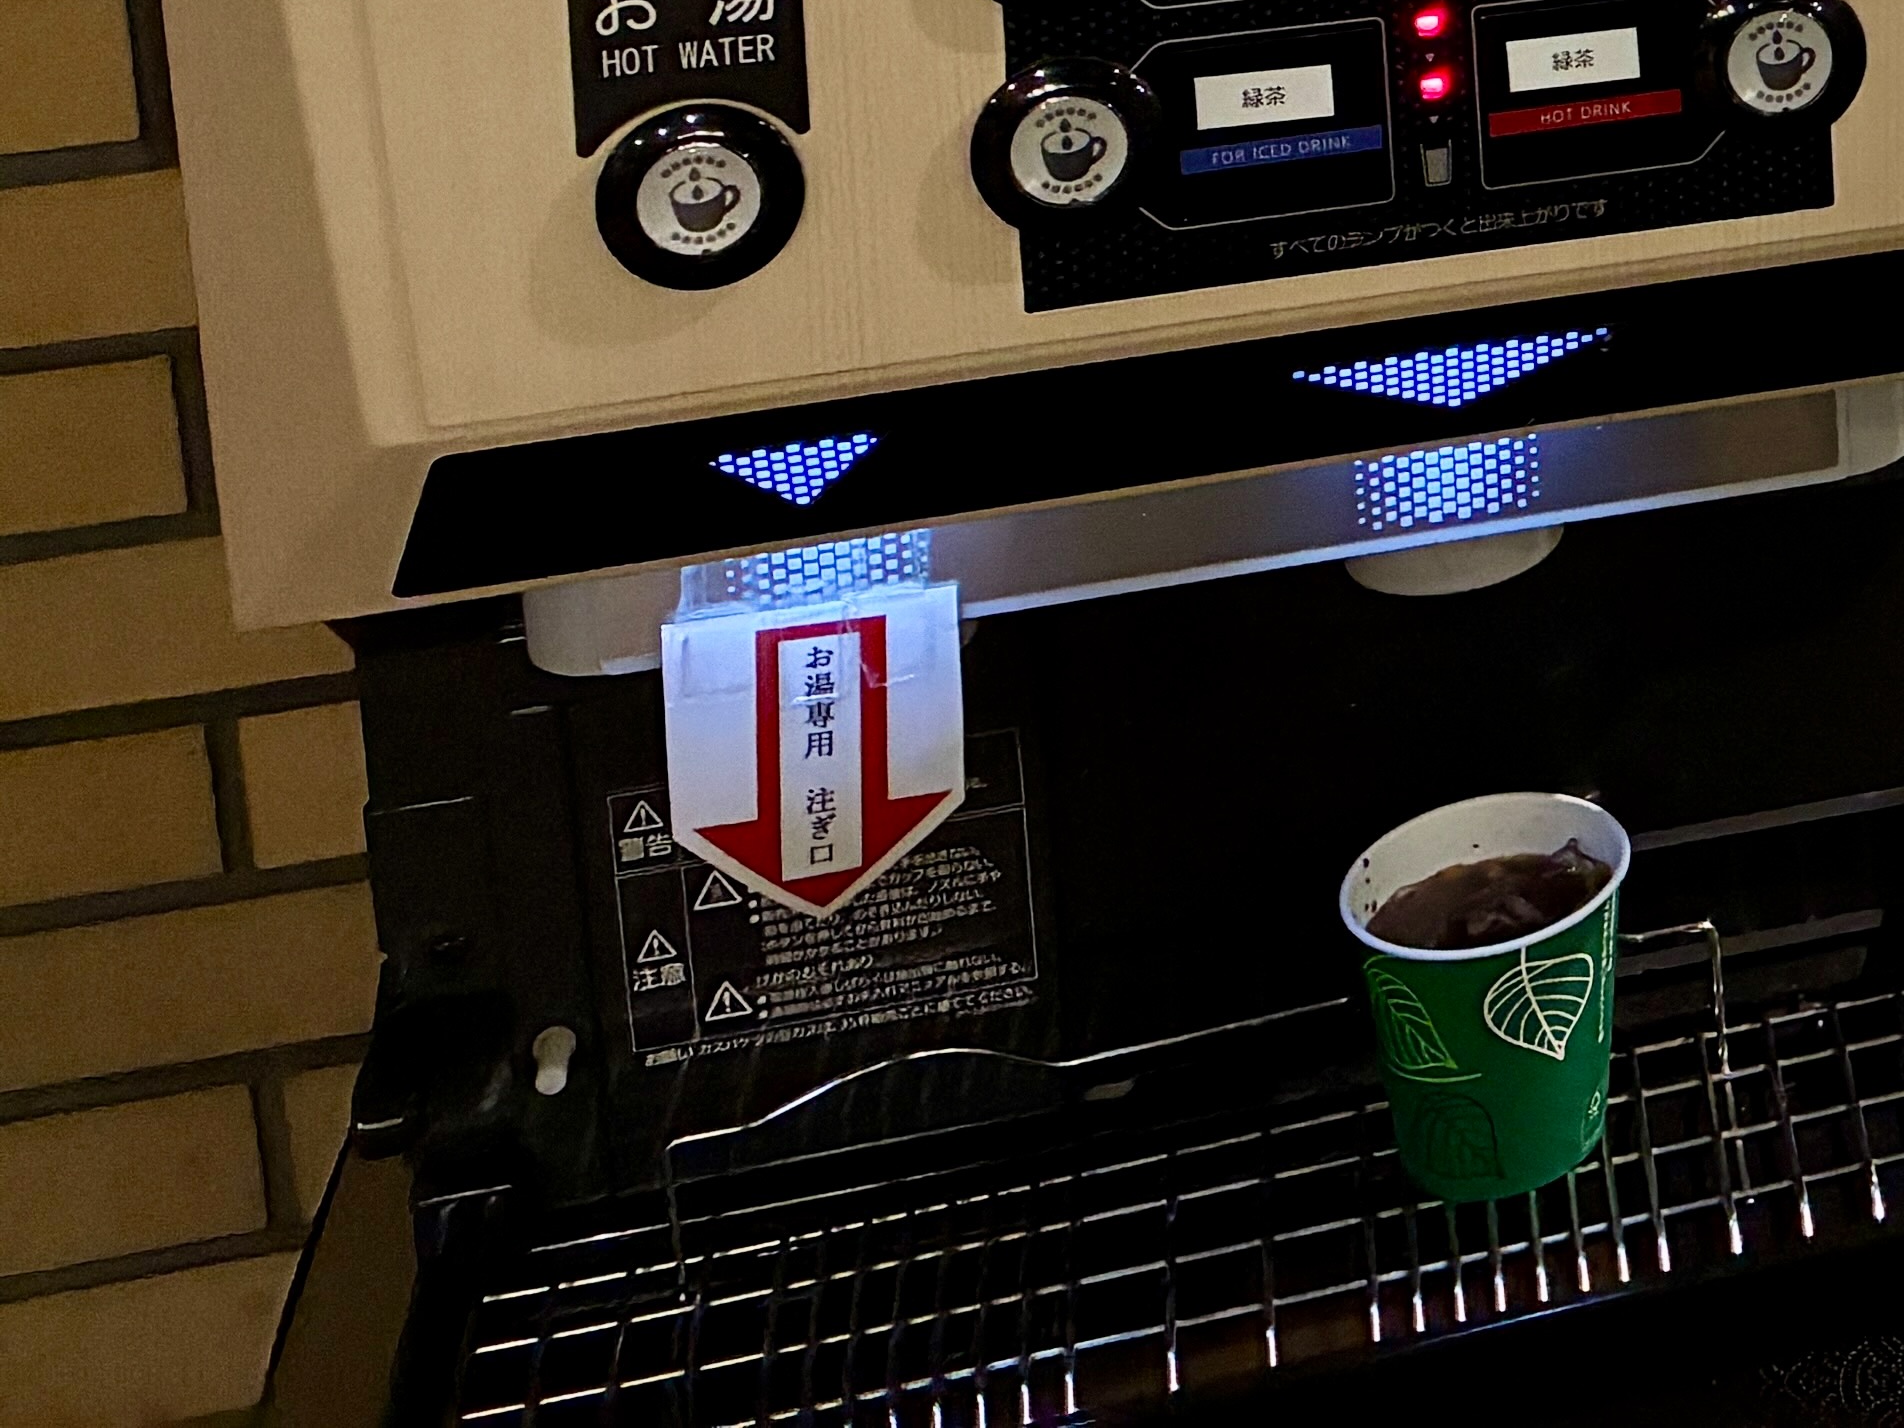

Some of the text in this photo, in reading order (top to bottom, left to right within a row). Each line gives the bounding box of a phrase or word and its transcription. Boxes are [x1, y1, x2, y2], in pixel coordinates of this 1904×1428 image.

[600, 33, 777, 79] HOT WATER
[1551, 47, 1596, 72] 緑茶
[1241, 84, 1287, 110] 緑茶
[1539, 99, 1633, 125] HOT DRINK
[1252, 142, 1292, 160] ICED
[803, 644, 838, 867] お湯専用 注ぎ口
